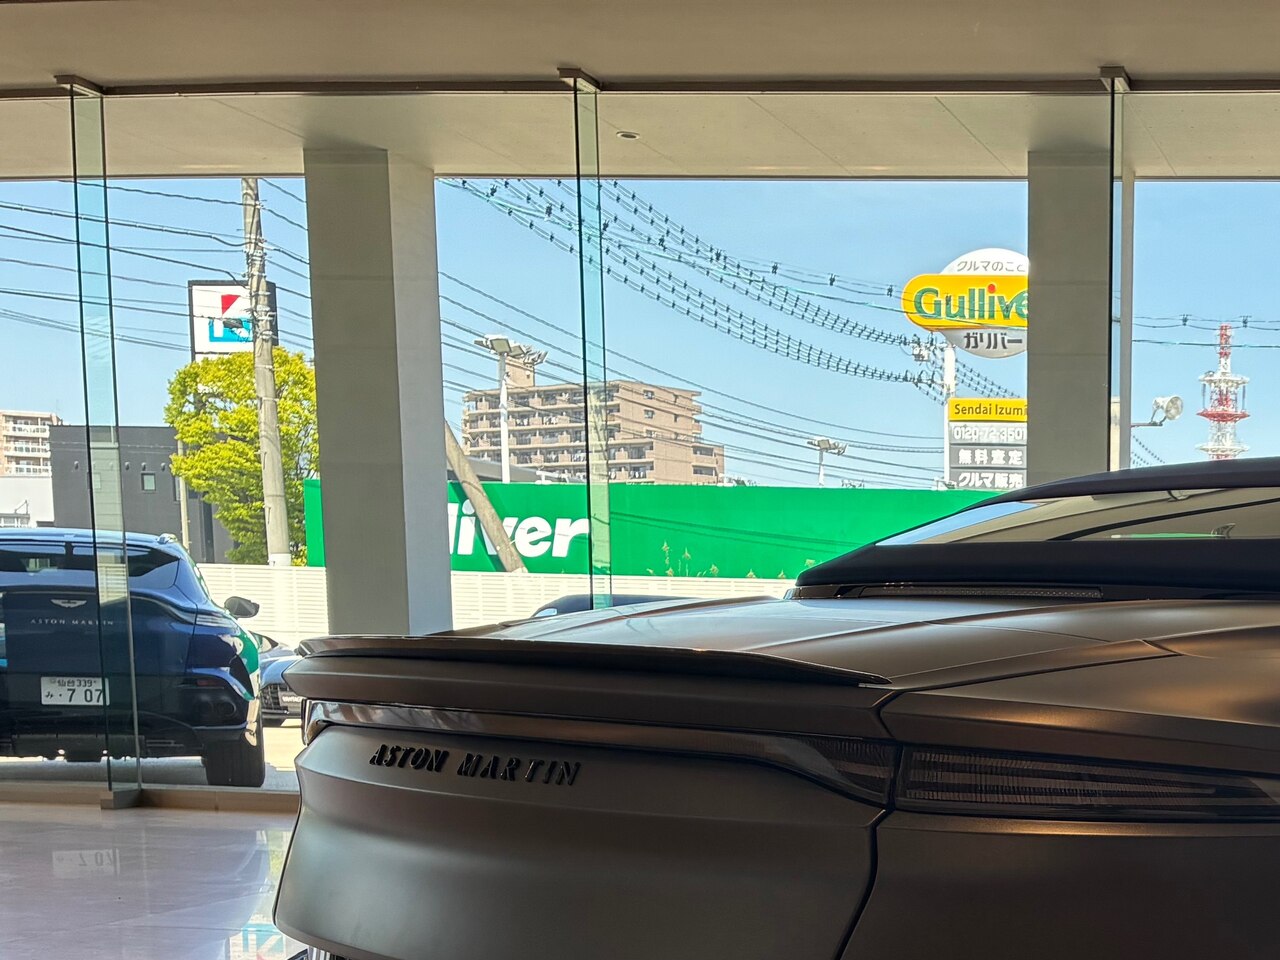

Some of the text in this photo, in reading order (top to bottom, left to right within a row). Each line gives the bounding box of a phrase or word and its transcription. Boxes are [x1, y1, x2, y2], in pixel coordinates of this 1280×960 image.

[963, 332, 1023, 350] ガリバー
[954, 403, 992, 415] Sendai
[958, 448, 1023, 465] 無料査定
[958, 471, 1024, 489] クルマ販売
[369, 744, 582, 786] ASTON MARTIN
